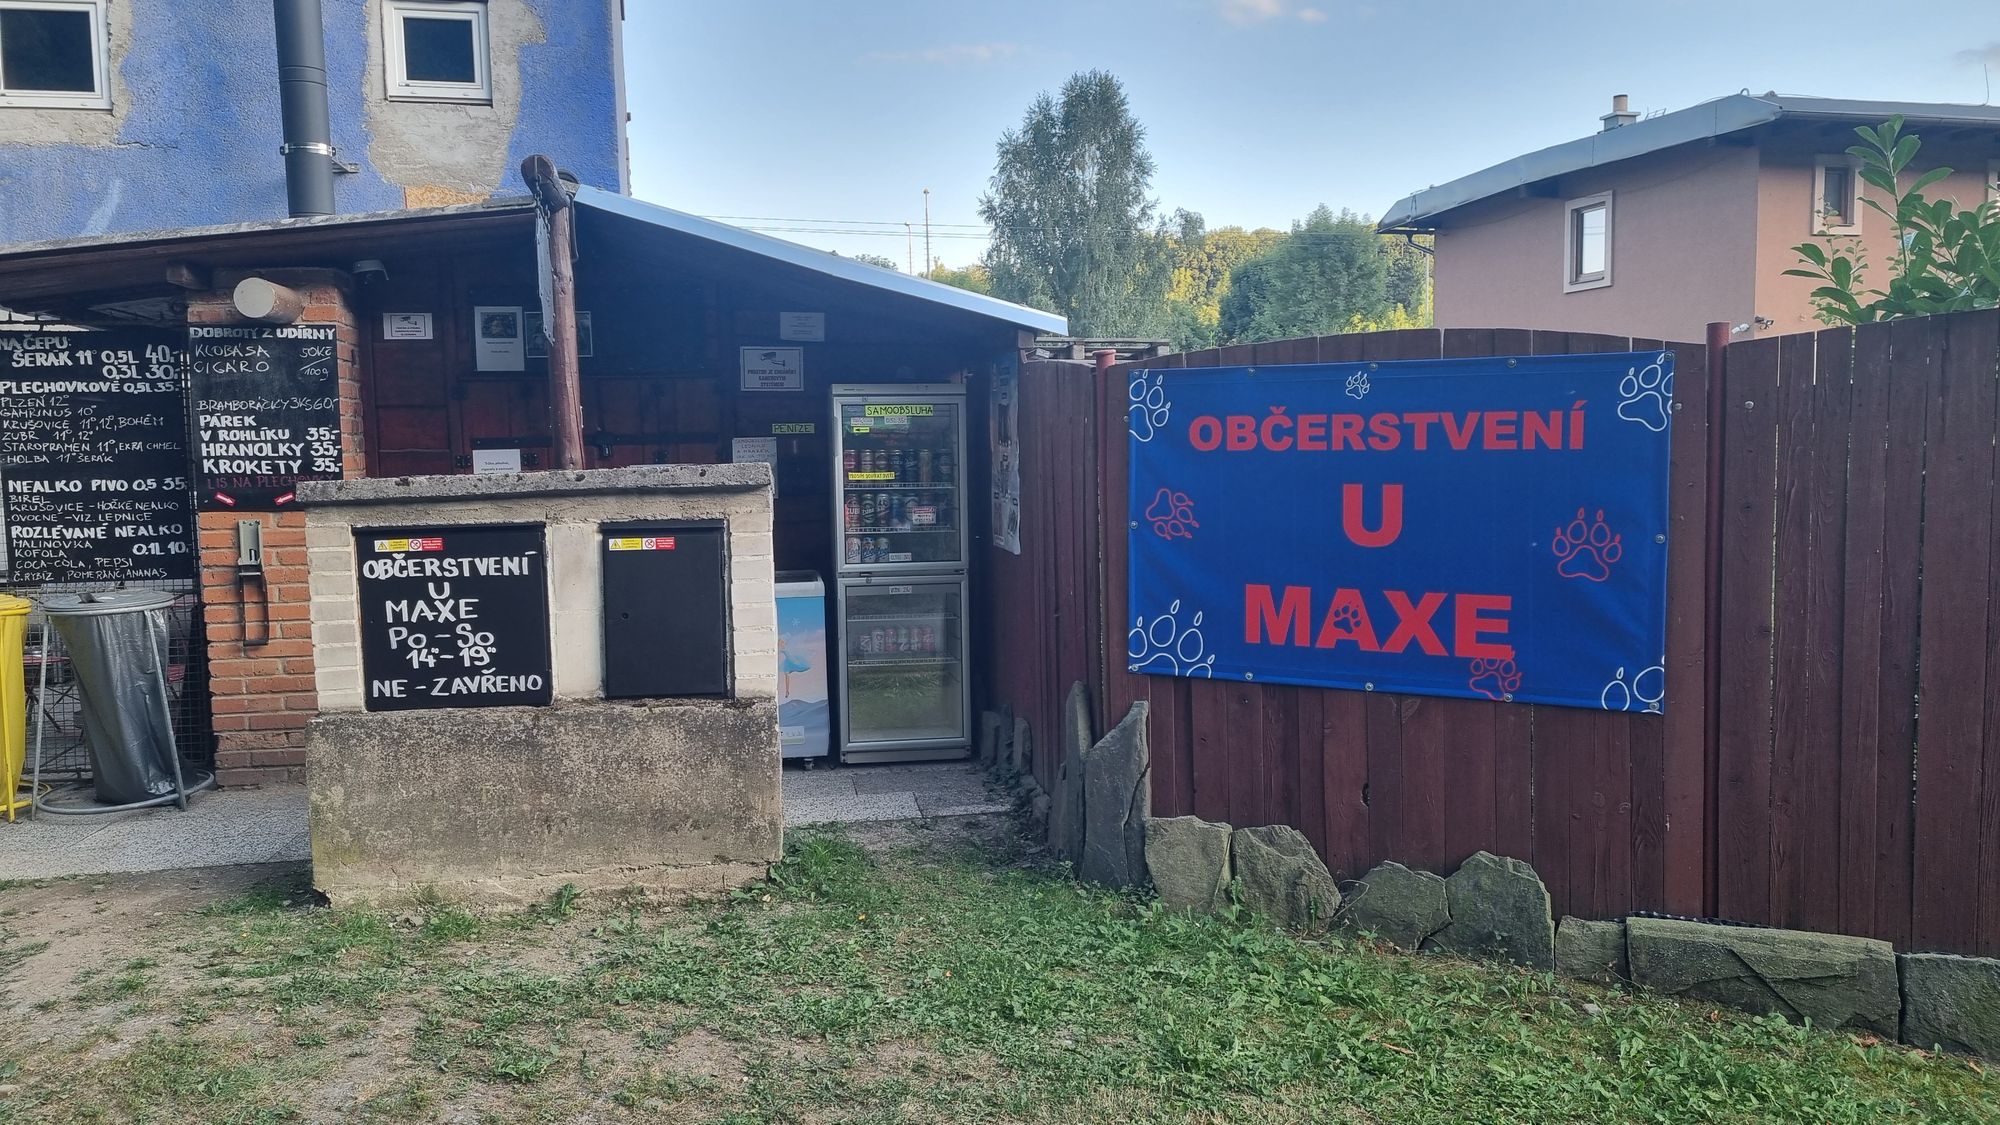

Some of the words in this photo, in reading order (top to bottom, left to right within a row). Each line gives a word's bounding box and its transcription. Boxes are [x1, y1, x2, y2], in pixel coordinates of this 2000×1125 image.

[189, 327, 258, 339] DOBROTY
[262, 328, 273, 338] Z
[275, 325, 335, 340] UDÍRNY
[0, 337, 21, 350] NA
[12, 349, 73, 367] ŠERÁK
[193, 360, 270, 374] CIGÁRO
[0, 380, 121, 394] PLECHOVKOVÉ
[1, 394, 46, 407] PLZEŇ
[196, 396, 289, 412] BRAMBORÁČKY
[866, 405, 933, 416] SAMOOBSLUHA
[3, 419, 70, 430] KRUŠOVICE
[118, 413, 164, 428] BOHÉM
[199, 413, 257, 428] PÁREK
[1189, 400, 1588, 452] OBČERSTVENÍ
[2, 431, 40, 441] ZUBR
[200, 429, 212, 441] V
[218, 427, 290, 441] ROHLÍKU
[2, 443, 90, 452] STAROPRAMEN
[146, 442, 183, 450] CHMEL
[201, 443, 305, 457] HRANOLKY
[7, 454, 50, 464] HOLBA
[203, 459, 303, 475] KROKETY
[8, 479, 83, 493] NEALKO
[91, 479, 129, 492] PIVO
[8, 495, 51, 504] BIREL
[10, 501, 84, 512] KRUŠOVICE
[135, 501, 179, 511] NEALKO
[98, 512, 153, 522] LEDNICE
[1342, 483, 1404, 549] U
[10, 522, 108, 540] ROZLÉVANÉ
[115, 523, 183, 538] NEALKO
[13, 540, 93, 549] MALINOVKA
[15, 549, 68, 558] KOFOLA
[94, 557, 133, 568] PEPSI
[362, 551, 538, 580] OBČERSTVENÍ
[125, 568, 168, 579] ANANAS
[428, 582, 450, 599] U
[385, 598, 480, 624] MAXE
[1245, 584, 1513, 660] MAXE
[372, 679, 408, 698] NE
[430, 667, 543, 697] ZAVŘENO
